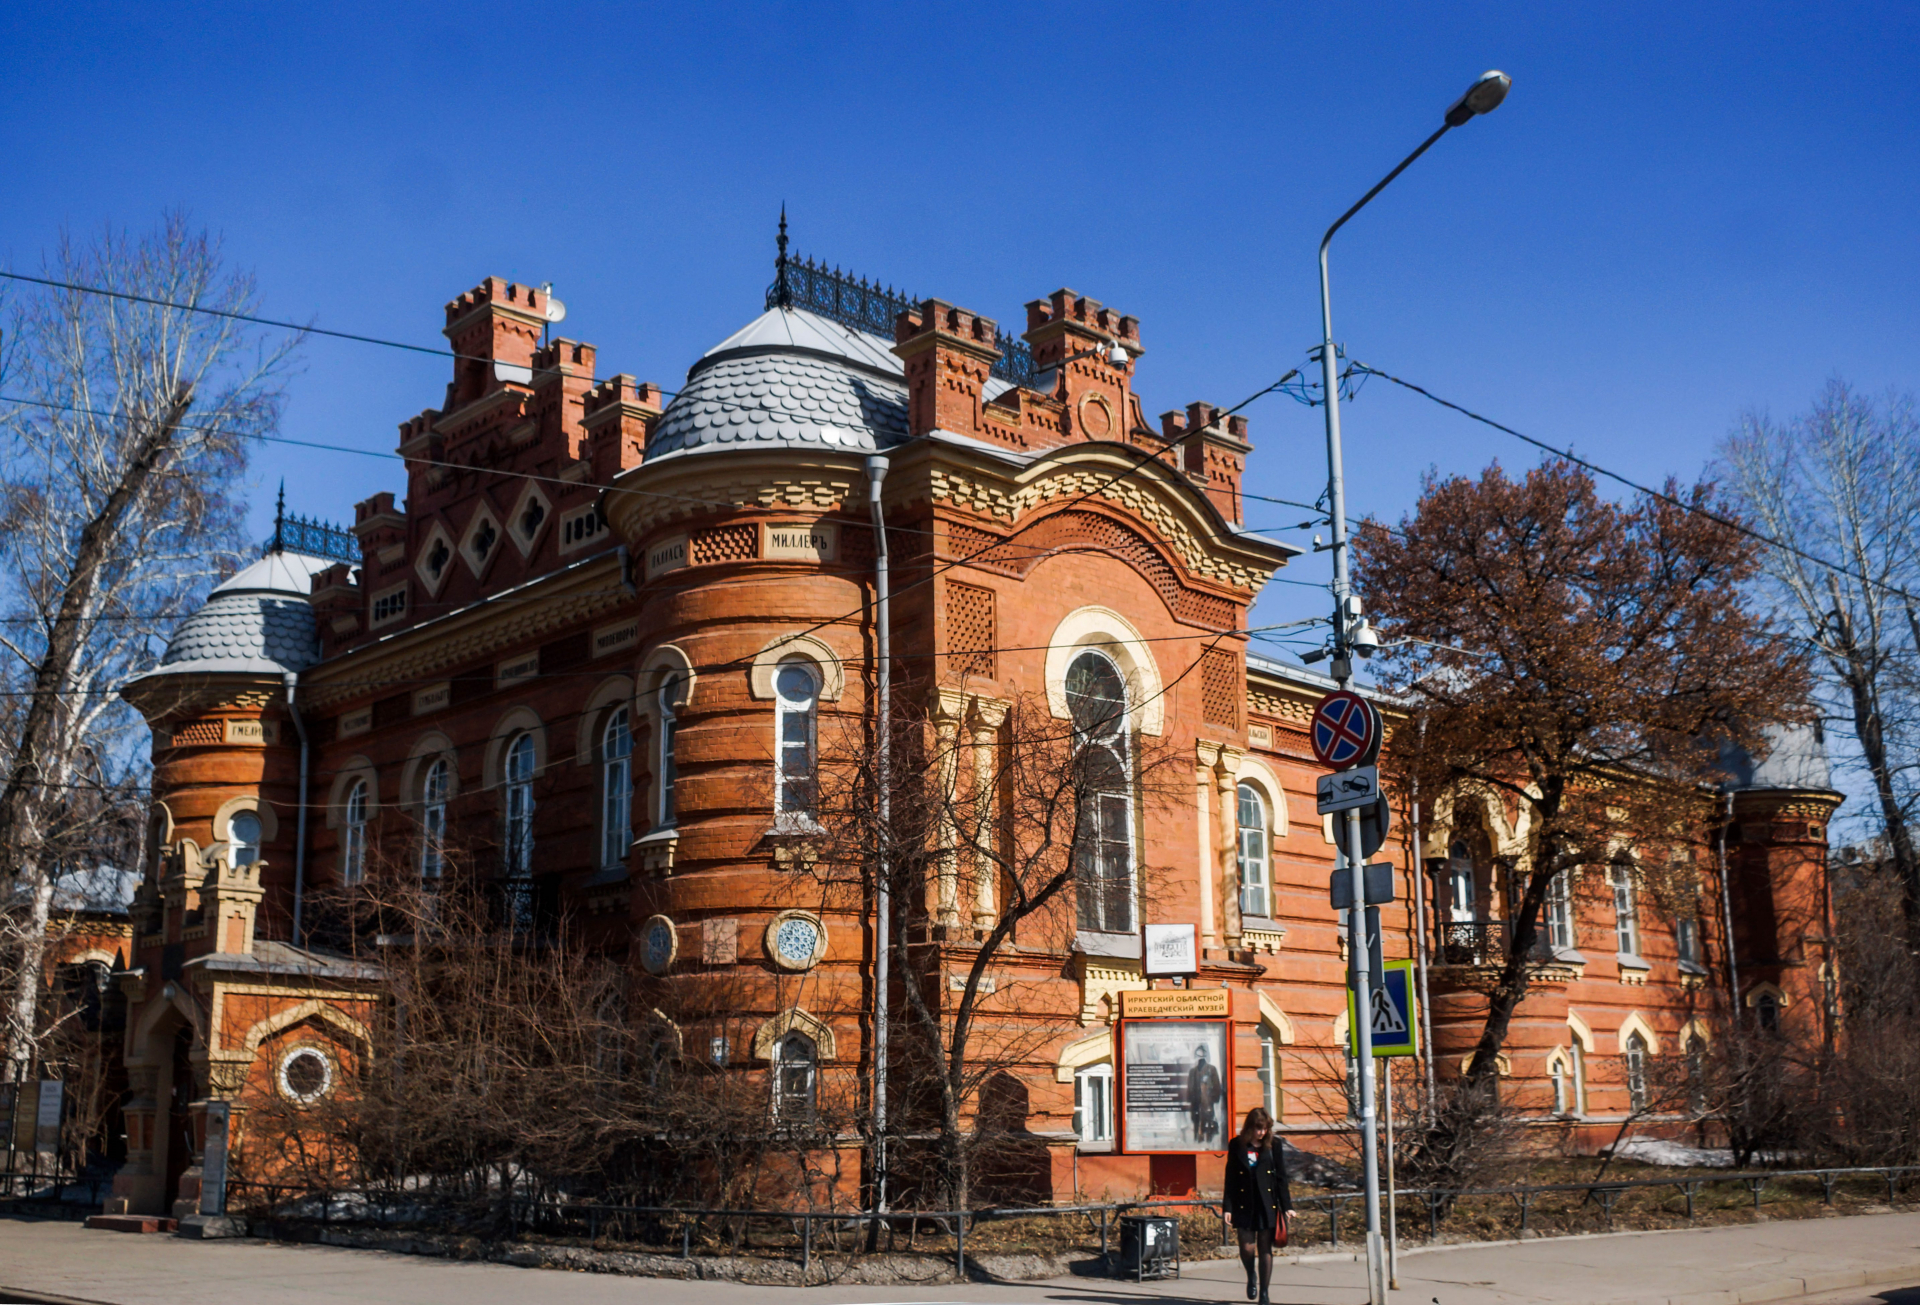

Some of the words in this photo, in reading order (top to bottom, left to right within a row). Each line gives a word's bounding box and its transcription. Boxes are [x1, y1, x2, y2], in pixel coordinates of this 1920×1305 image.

[772, 534, 827, 550] МИЛЛЕРЪ
[375, 590, 405, 621] 1883
[1128, 994, 1174, 1004] ИРКУТСКИЙ
[1176, 994, 1224, 1003] ОБЛАСТНОЙ
[1128, 1004, 1194, 1013] КРАЕВЕДЧЕСКИЙ
[1197, 1003, 1225, 1012] МУЗЕЙ
